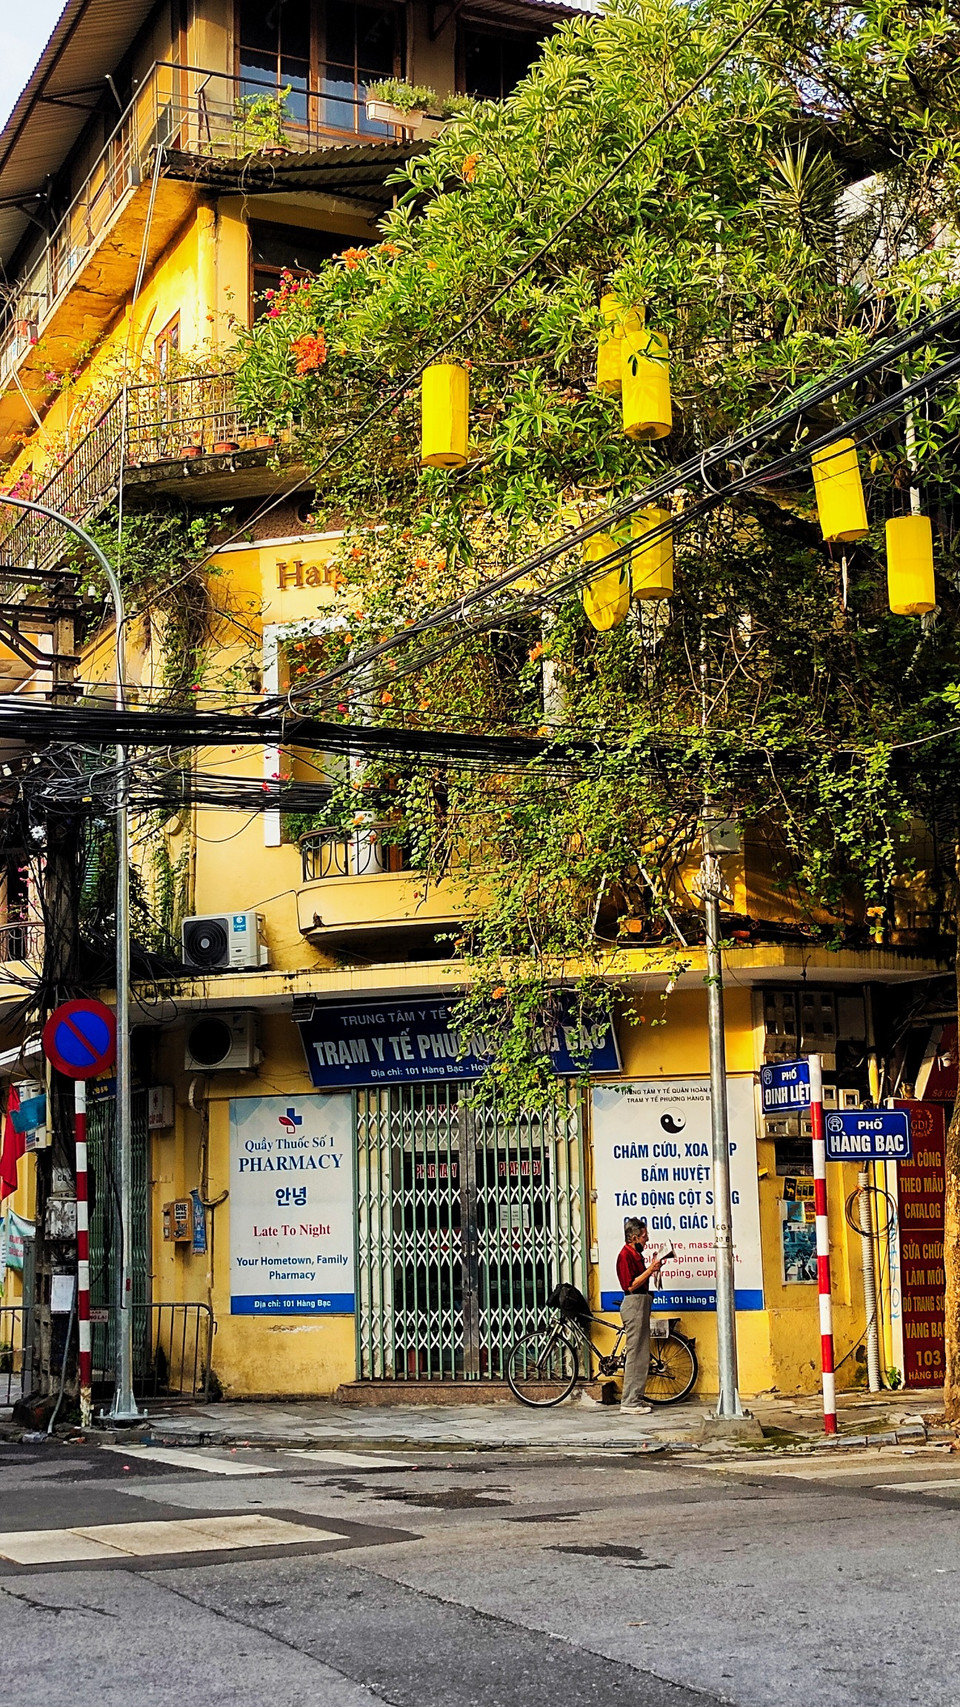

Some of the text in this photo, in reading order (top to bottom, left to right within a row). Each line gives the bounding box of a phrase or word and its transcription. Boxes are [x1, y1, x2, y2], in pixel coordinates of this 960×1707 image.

[340, 1005, 448, 1026] TRUNG TÂM Y TẾ
[312, 1037, 370, 1069] TRẠM
[371, 1037, 385, 1062] Y
[388, 1027, 415, 1061] TẾ
[370, 1069, 386, 1078] Địa
[405, 1067, 420, 1076] 101
[422, 1065, 445, 1076] Hàng
[446, 1064, 464, 1074] Bạc
[781, 1067, 797, 1081] PHỐ
[765, 1080, 811, 1105] ĐINH LIỆT
[857, 1117, 884, 1130] PHỐ
[244, 1134, 334, 1152] Quầy Thuốc Số 1
[613, 1142, 649, 1159] CHÂM
[652, 1141, 681, 1159] CỨU,
[684, 1143, 709, 1157] XOA
[830, 1130, 904, 1155] HÀNG BẠC
[239, 1153, 344, 1173] PHARMACY
[917, 1149, 941, 1167] CÔNG
[641, 1163, 711, 1184] BẤM HUYỆT
[900, 1177, 922, 1193] THEO
[275, 1186, 307, 1207] 안녕
[615, 1188, 740, 1209] TÁC ĐỘNG CỘT SG
[175, 1204, 187, 1212] BNE
[904, 1202, 941, 1219] CATALOG
[651, 1212, 676, 1231] GIÓ,
[679, 1212, 708, 1229] GIÁC
[253, 1223, 331, 1238] Late To Night
[902, 1238, 921, 1260] SỬA
[236, 1254, 348, 1267] Your Hometown, Family
[673, 1255, 704, 1265] spinne
[269, 1270, 316, 1281] Pharmacy
[906, 1266, 945, 1286] LÀM MỚI
[296, 1299, 315, 1308] Hàng
[317, 1299, 331, 1308] Bạc
[670, 1296, 684, 1304] 101
[687, 1295, 707, 1305] Hàng
[913, 1296, 935, 1312] TRANG
[905, 1319, 945, 1341] VÀNG BẠ
[916, 1350, 941, 1366] 103
[908, 1369, 931, 1380] HÀNG
